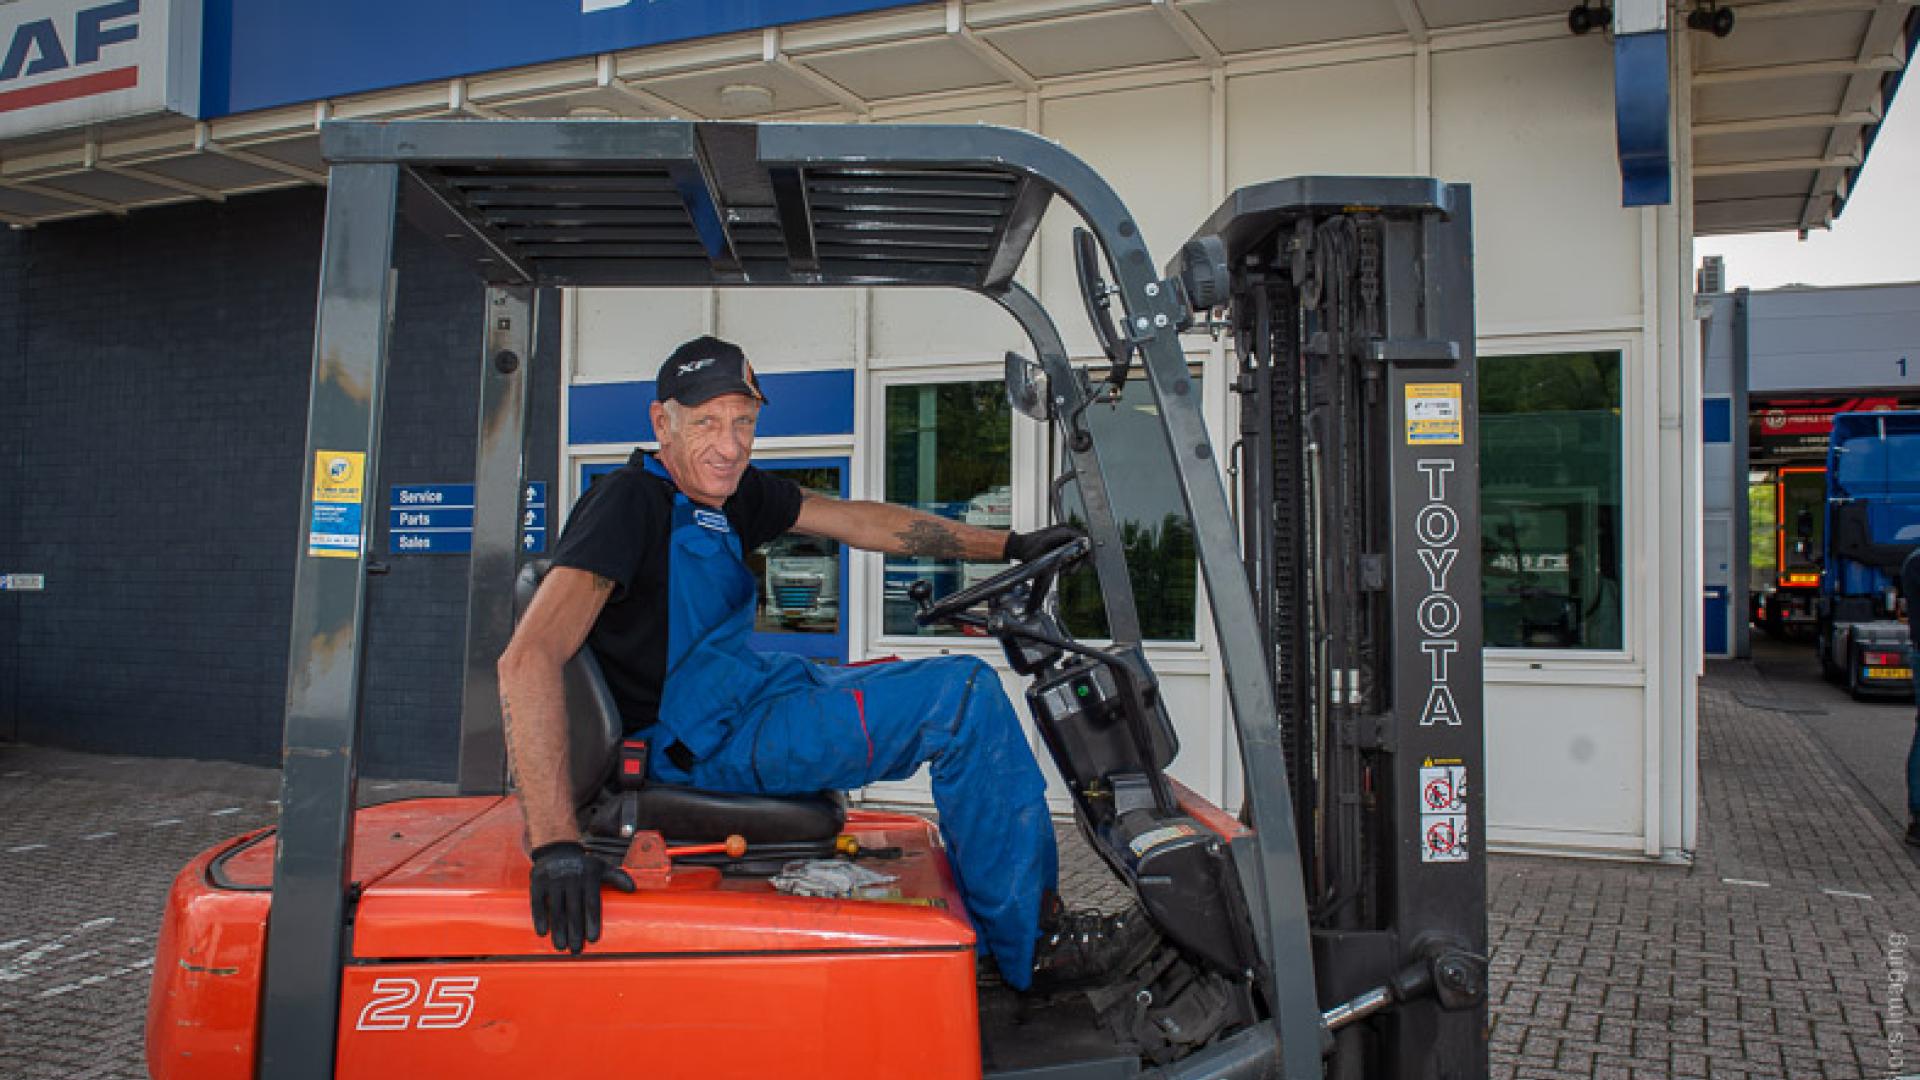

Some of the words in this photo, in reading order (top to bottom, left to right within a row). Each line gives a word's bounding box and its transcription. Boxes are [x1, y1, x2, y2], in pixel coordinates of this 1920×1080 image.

[1895, 358, 1906, 377] 1
[399, 490, 443, 503] Service
[399, 512, 430, 525] Parts
[399, 534, 430, 549] Sales
[1416, 458, 1462, 726] TOYOTA
[356, 976, 479, 1030] 25
